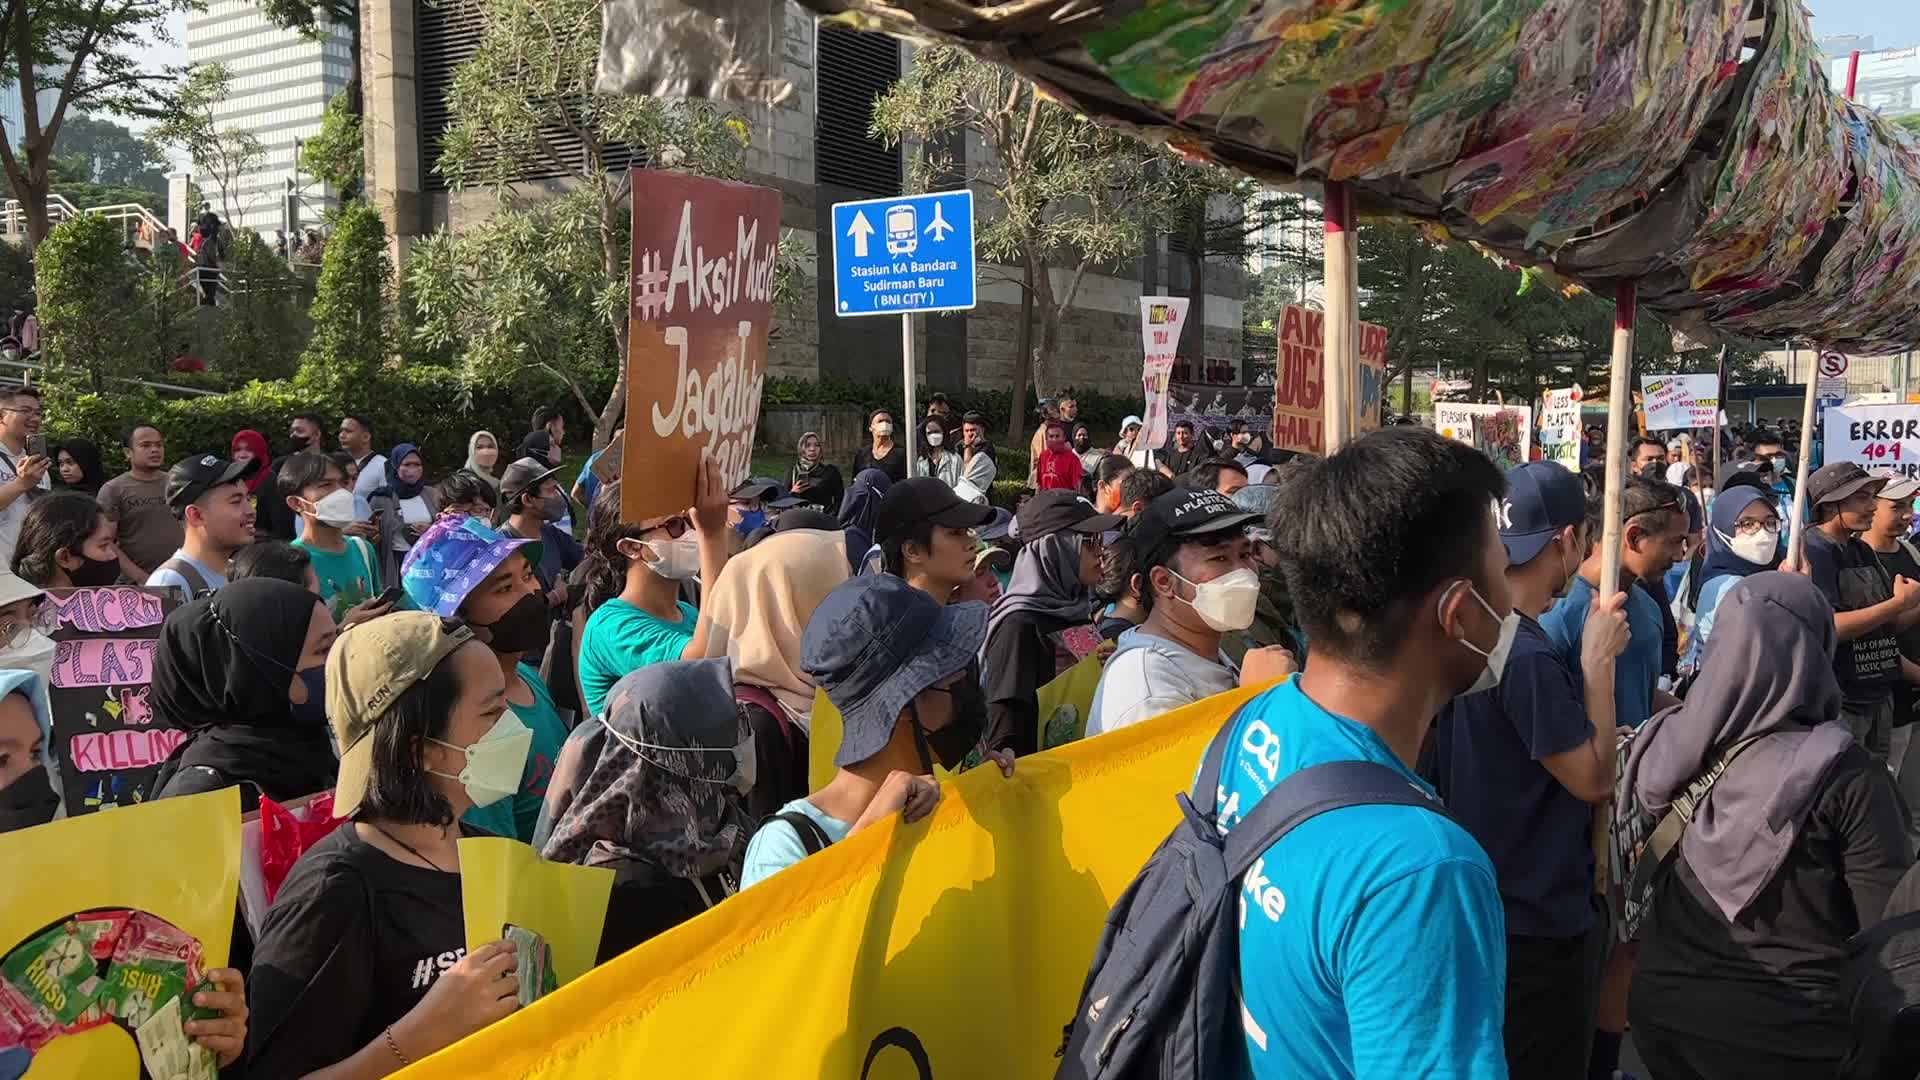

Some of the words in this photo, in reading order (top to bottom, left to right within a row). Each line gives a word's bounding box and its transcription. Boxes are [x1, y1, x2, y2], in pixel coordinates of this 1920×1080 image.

[850, 264, 889, 277] Stasiun
[892, 262, 908, 274] KA
[911, 259, 957, 273] Bandara
[863, 279, 915, 292] Sudirman
[918, 277, 944, 288] Baru
[1553, 395, 1569, 409] LESS
[1850, 419, 1920, 441] ERROR
[1861, 441, 1901, 460] 404
[52, 641, 157, 687] PLAST
[367, 684, 393, 711] RUN
